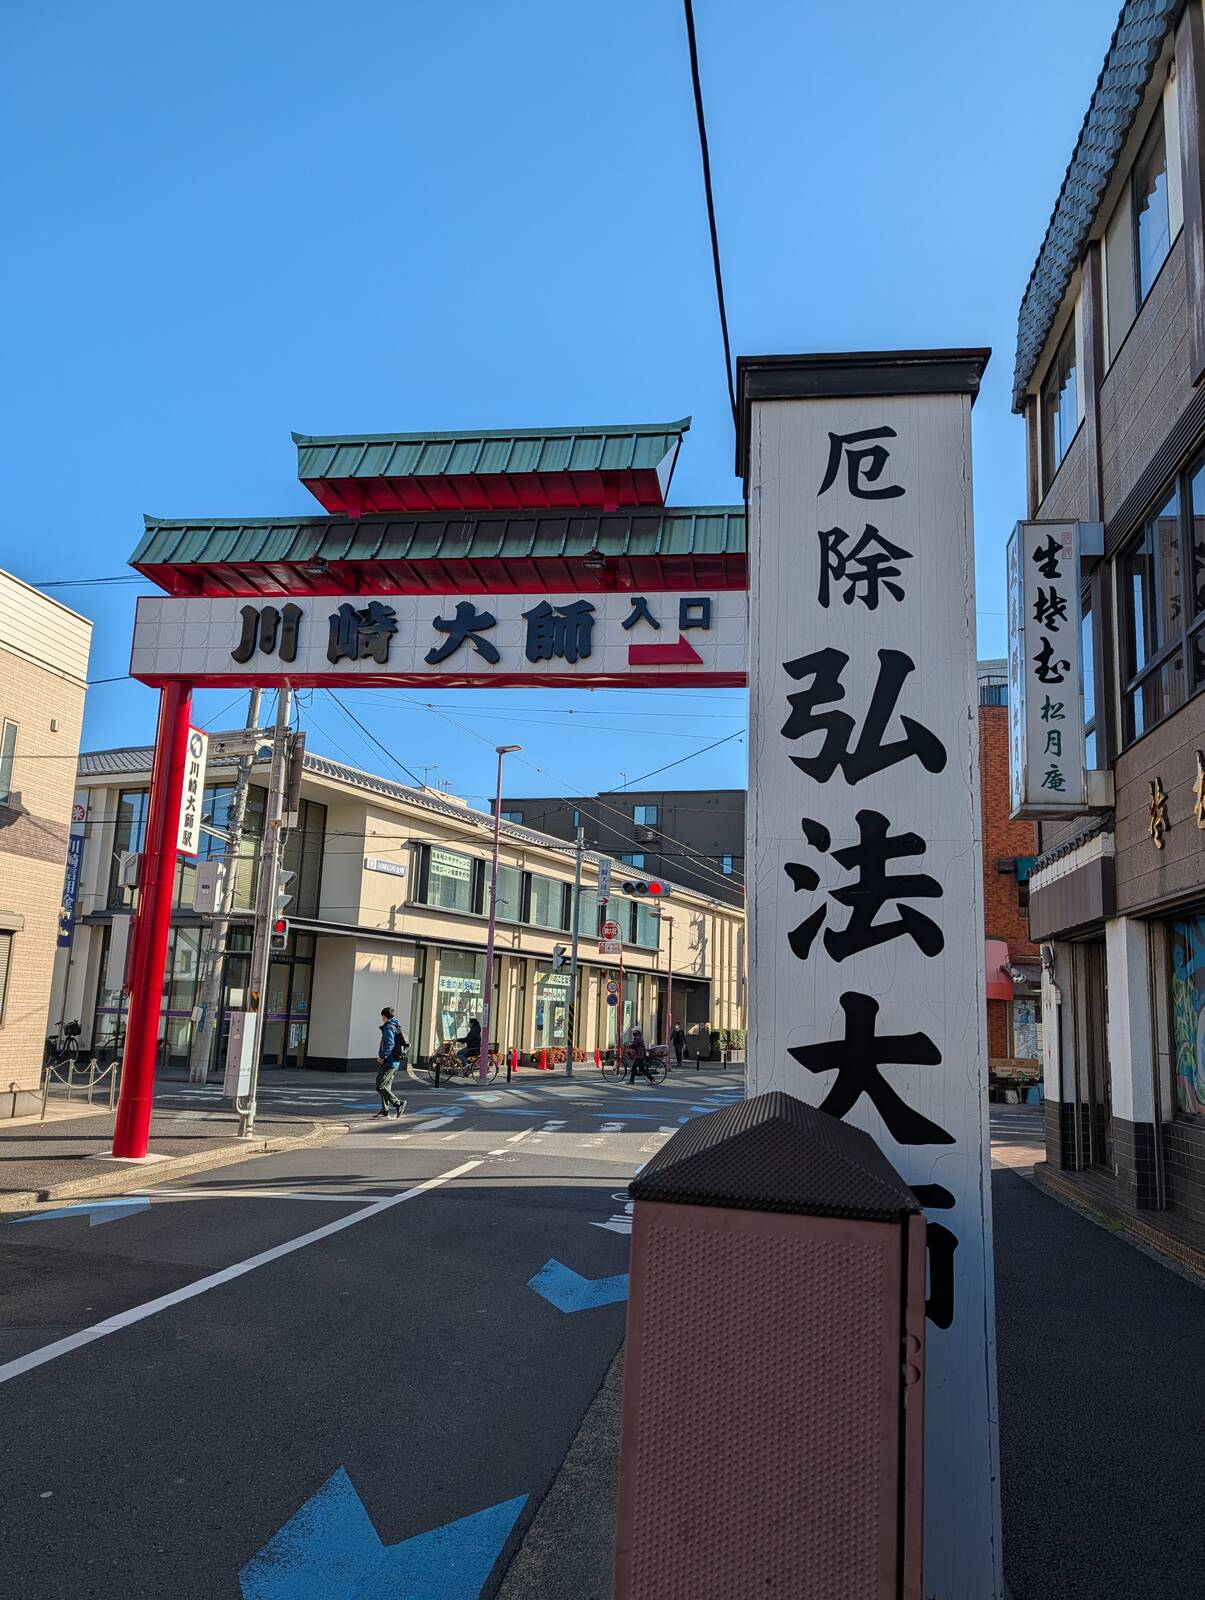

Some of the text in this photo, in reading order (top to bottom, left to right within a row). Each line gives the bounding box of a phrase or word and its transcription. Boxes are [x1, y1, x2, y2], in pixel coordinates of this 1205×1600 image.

[230, 596, 711, 665] 川崎大師 入口
[1040, 694, 1067, 793] 松月庵
[181, 762, 200, 848] 川崎大師駅
[62, 840, 81, 910] 川崎信用金
[780, 425, 957, 1329] 厄除弘法大
